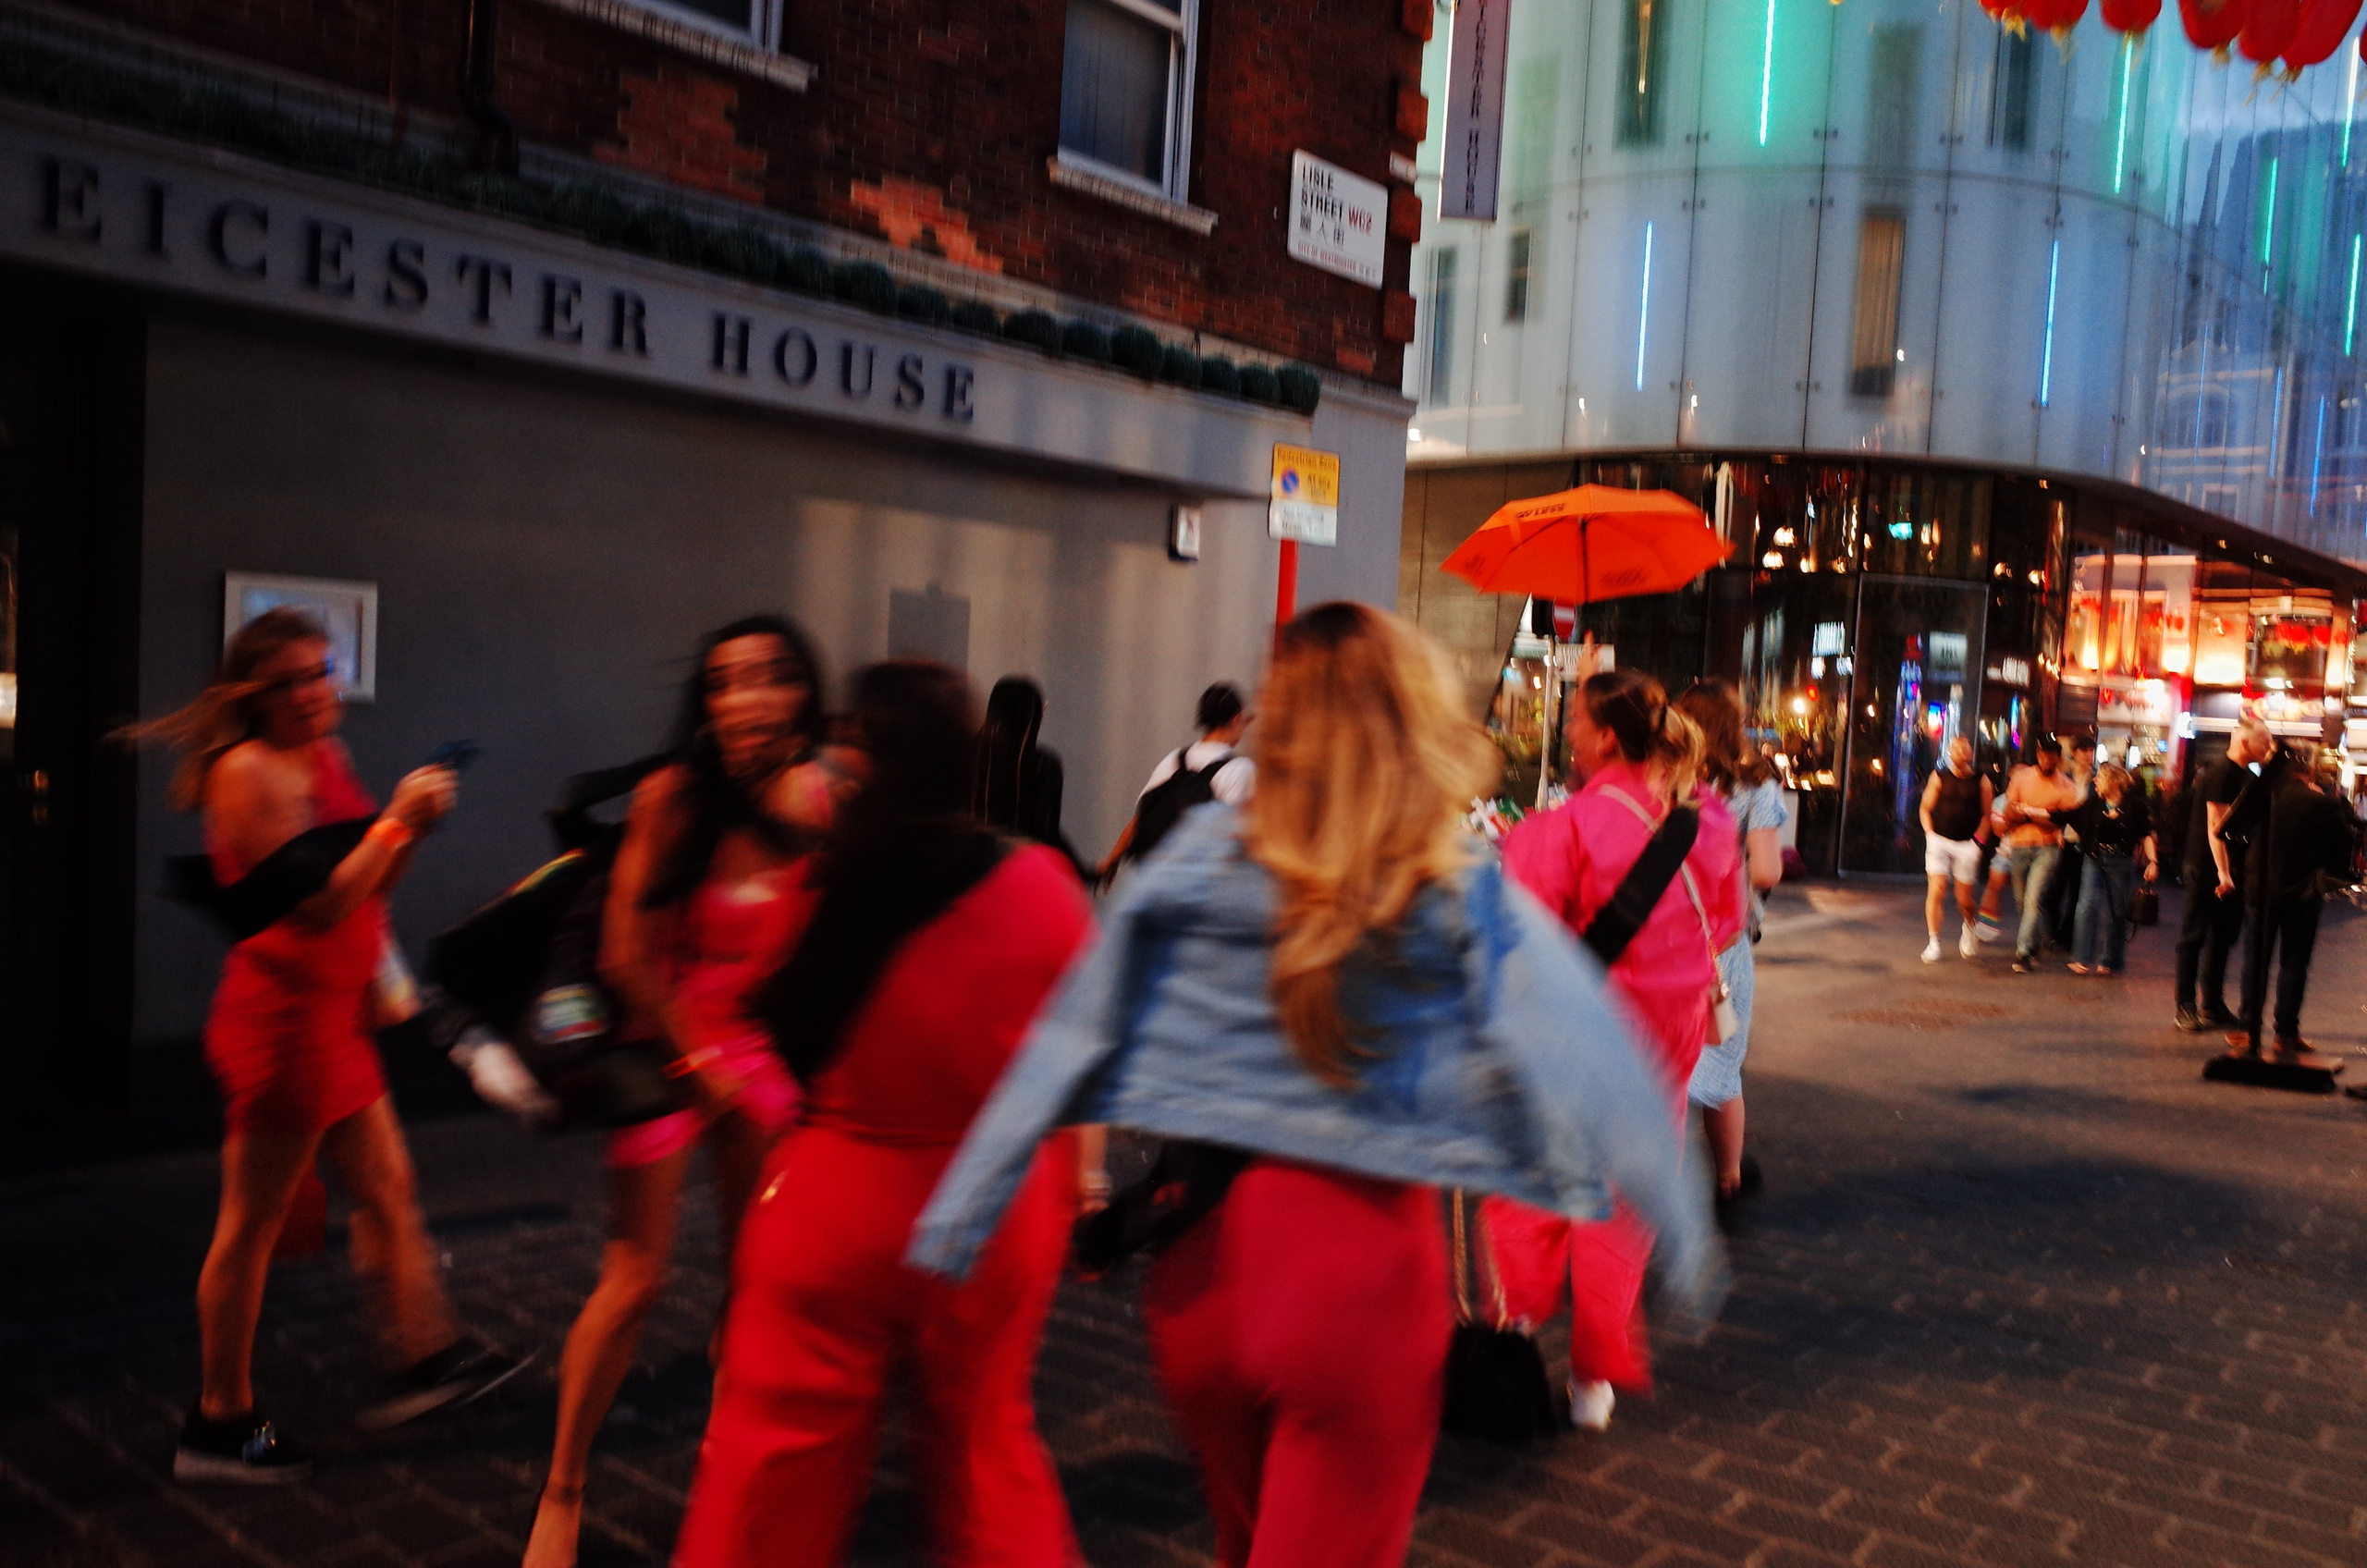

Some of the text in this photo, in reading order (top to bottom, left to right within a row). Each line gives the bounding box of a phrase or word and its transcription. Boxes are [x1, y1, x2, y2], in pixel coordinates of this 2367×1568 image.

[1302, 162, 1333, 194] LISLE
[1301, 186, 1372, 234] STREET WC2
[38, 153, 975, 422] EICESTER HOUSE
